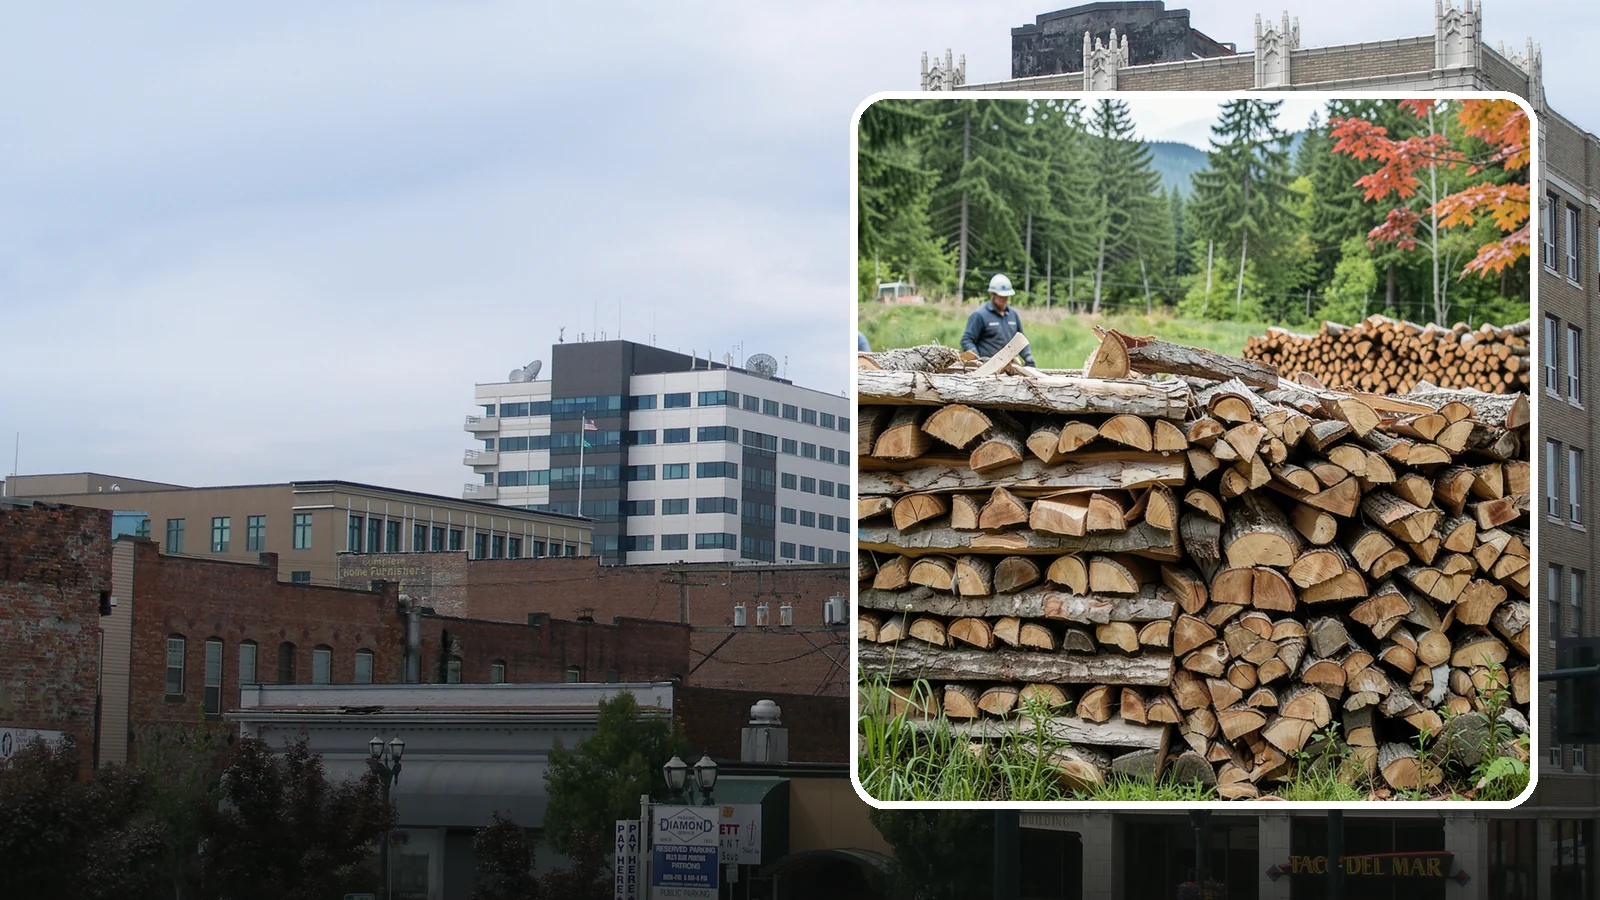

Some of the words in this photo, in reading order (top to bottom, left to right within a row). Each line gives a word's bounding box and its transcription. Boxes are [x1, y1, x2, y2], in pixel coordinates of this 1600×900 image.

[660, 818, 713, 832] DIAMOND
[1022, 815, 1070, 828] BUILDING
[617, 825, 625, 852] PAY
[628, 824, 636, 852] PAY
[655, 845, 688, 853] RESERVED
[689, 846, 716, 854] PARKING
[721, 851, 739, 862] Soup
[671, 862, 701, 870] PATRONS
[1346, 856, 1385, 876] DEL
[1392, 856, 1442, 877] MAR
[616, 856, 625, 893] HERE
[627, 856, 636, 893] HERE
[660, 888, 682, 897] PUBLIC
[683, 889, 710, 898] PARKING
